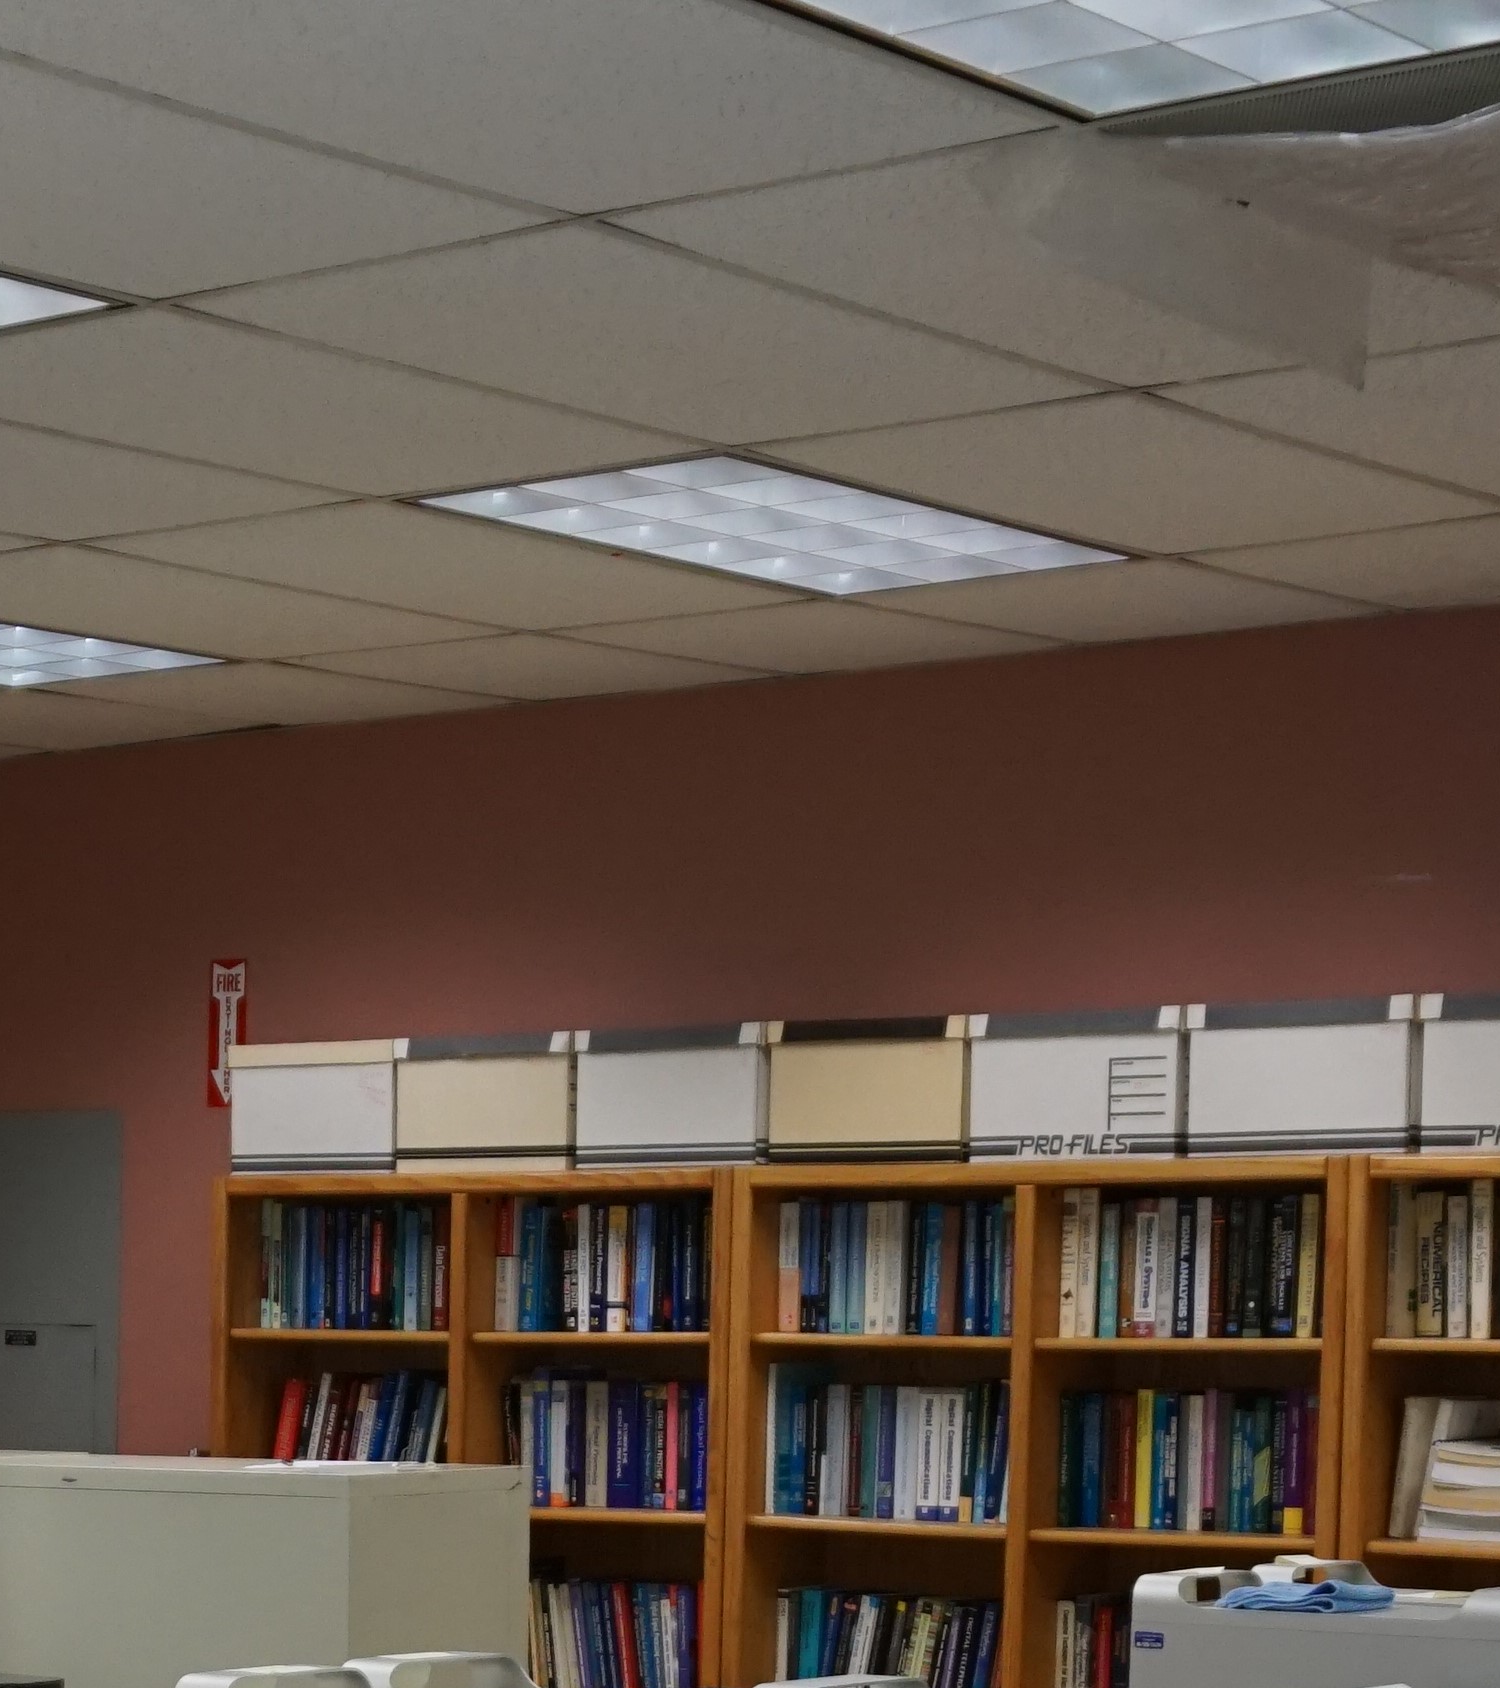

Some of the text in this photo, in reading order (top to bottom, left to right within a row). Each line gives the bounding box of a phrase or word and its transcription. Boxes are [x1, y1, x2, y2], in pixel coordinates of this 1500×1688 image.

[216, 973, 242, 993] FIRE
[1018, 1133, 1128, 1156] PRO-FILES
[435, 1245, 446, 1265] Data
[1476, 1236, 1487, 1250] and
[1177, 1215, 1191, 1319] SIGNAL ANALYSIS
[1420, 1236, 1431, 1305] RECIPES
[1431, 1221, 1444, 1318] NUMERICAL
[1474, 1252, 1487, 1284] Systems
[1141, 1266, 1154, 1310] SYSTEMS
[326, 1403, 338, 1437] DIGITAL
[695, 1397, 705, 1489] Digital Signal Processing
[921, 1398, 934, 1501] Digital Communications
[944, 1398, 957, 1502] Digital Communications
[963, 1616, 974, 1648] DIGITAL
